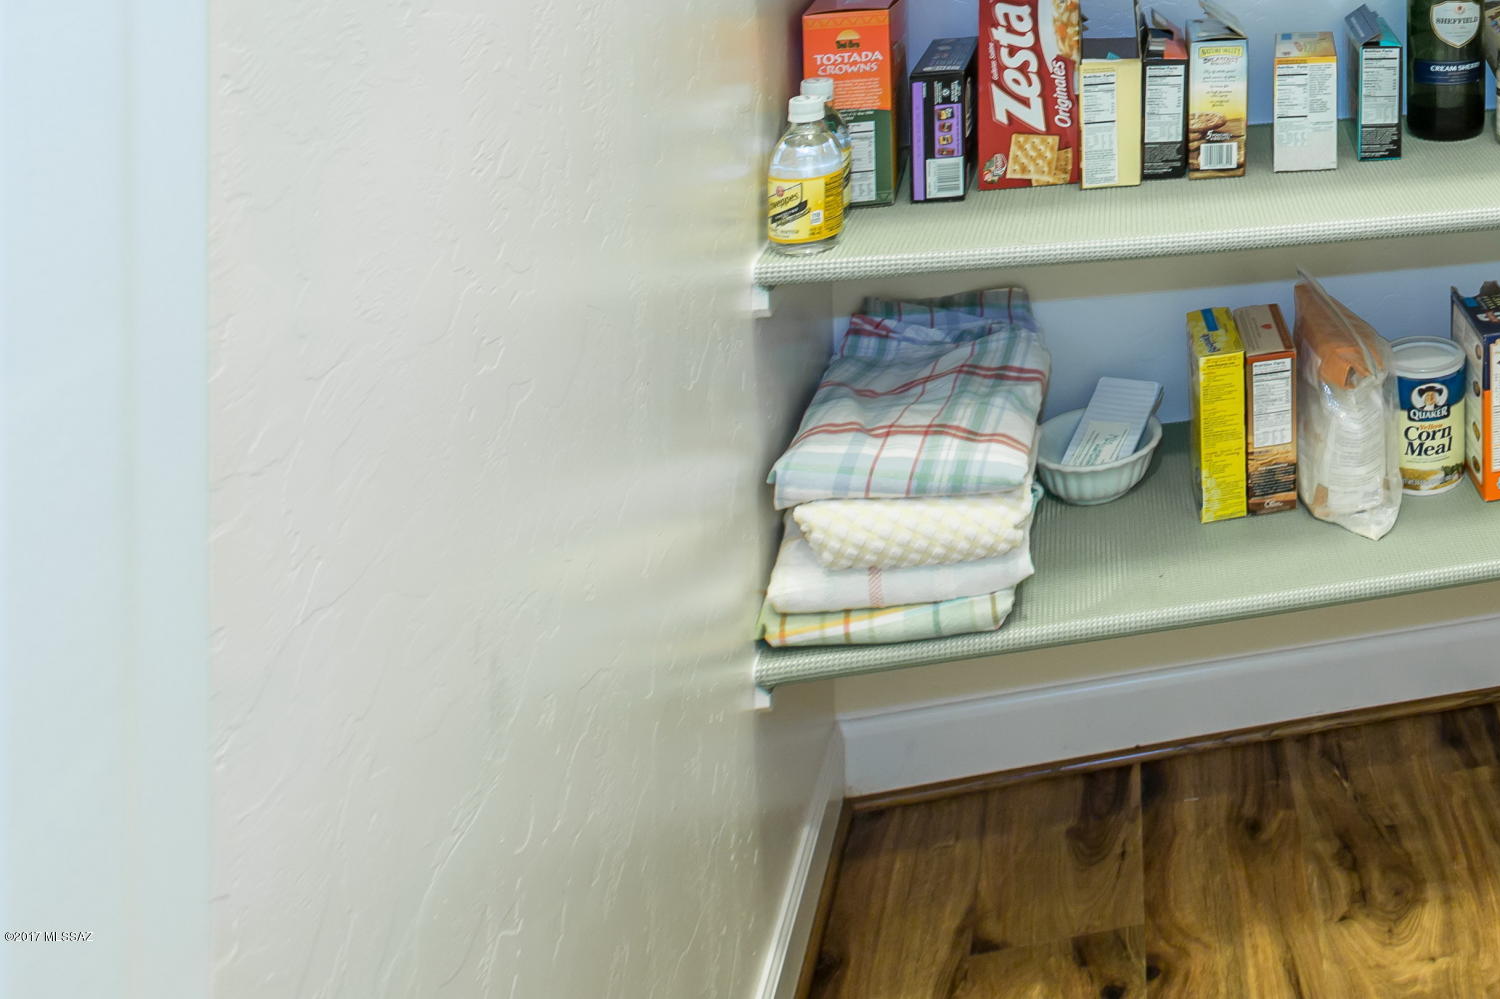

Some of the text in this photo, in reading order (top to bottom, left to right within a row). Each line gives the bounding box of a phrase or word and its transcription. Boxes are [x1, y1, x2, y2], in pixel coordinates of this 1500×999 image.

[814, 50, 884, 65] TOSTADA
[818, 62, 880, 76] CROWNS
[990, 2, 1047, 132] Zesta
[1051, 60, 1073, 128] Originales
[1410, 406, 1448, 420] QUAKER
[1404, 426, 1452, 442] Corn
[1404, 436, 1452, 456] Meal
